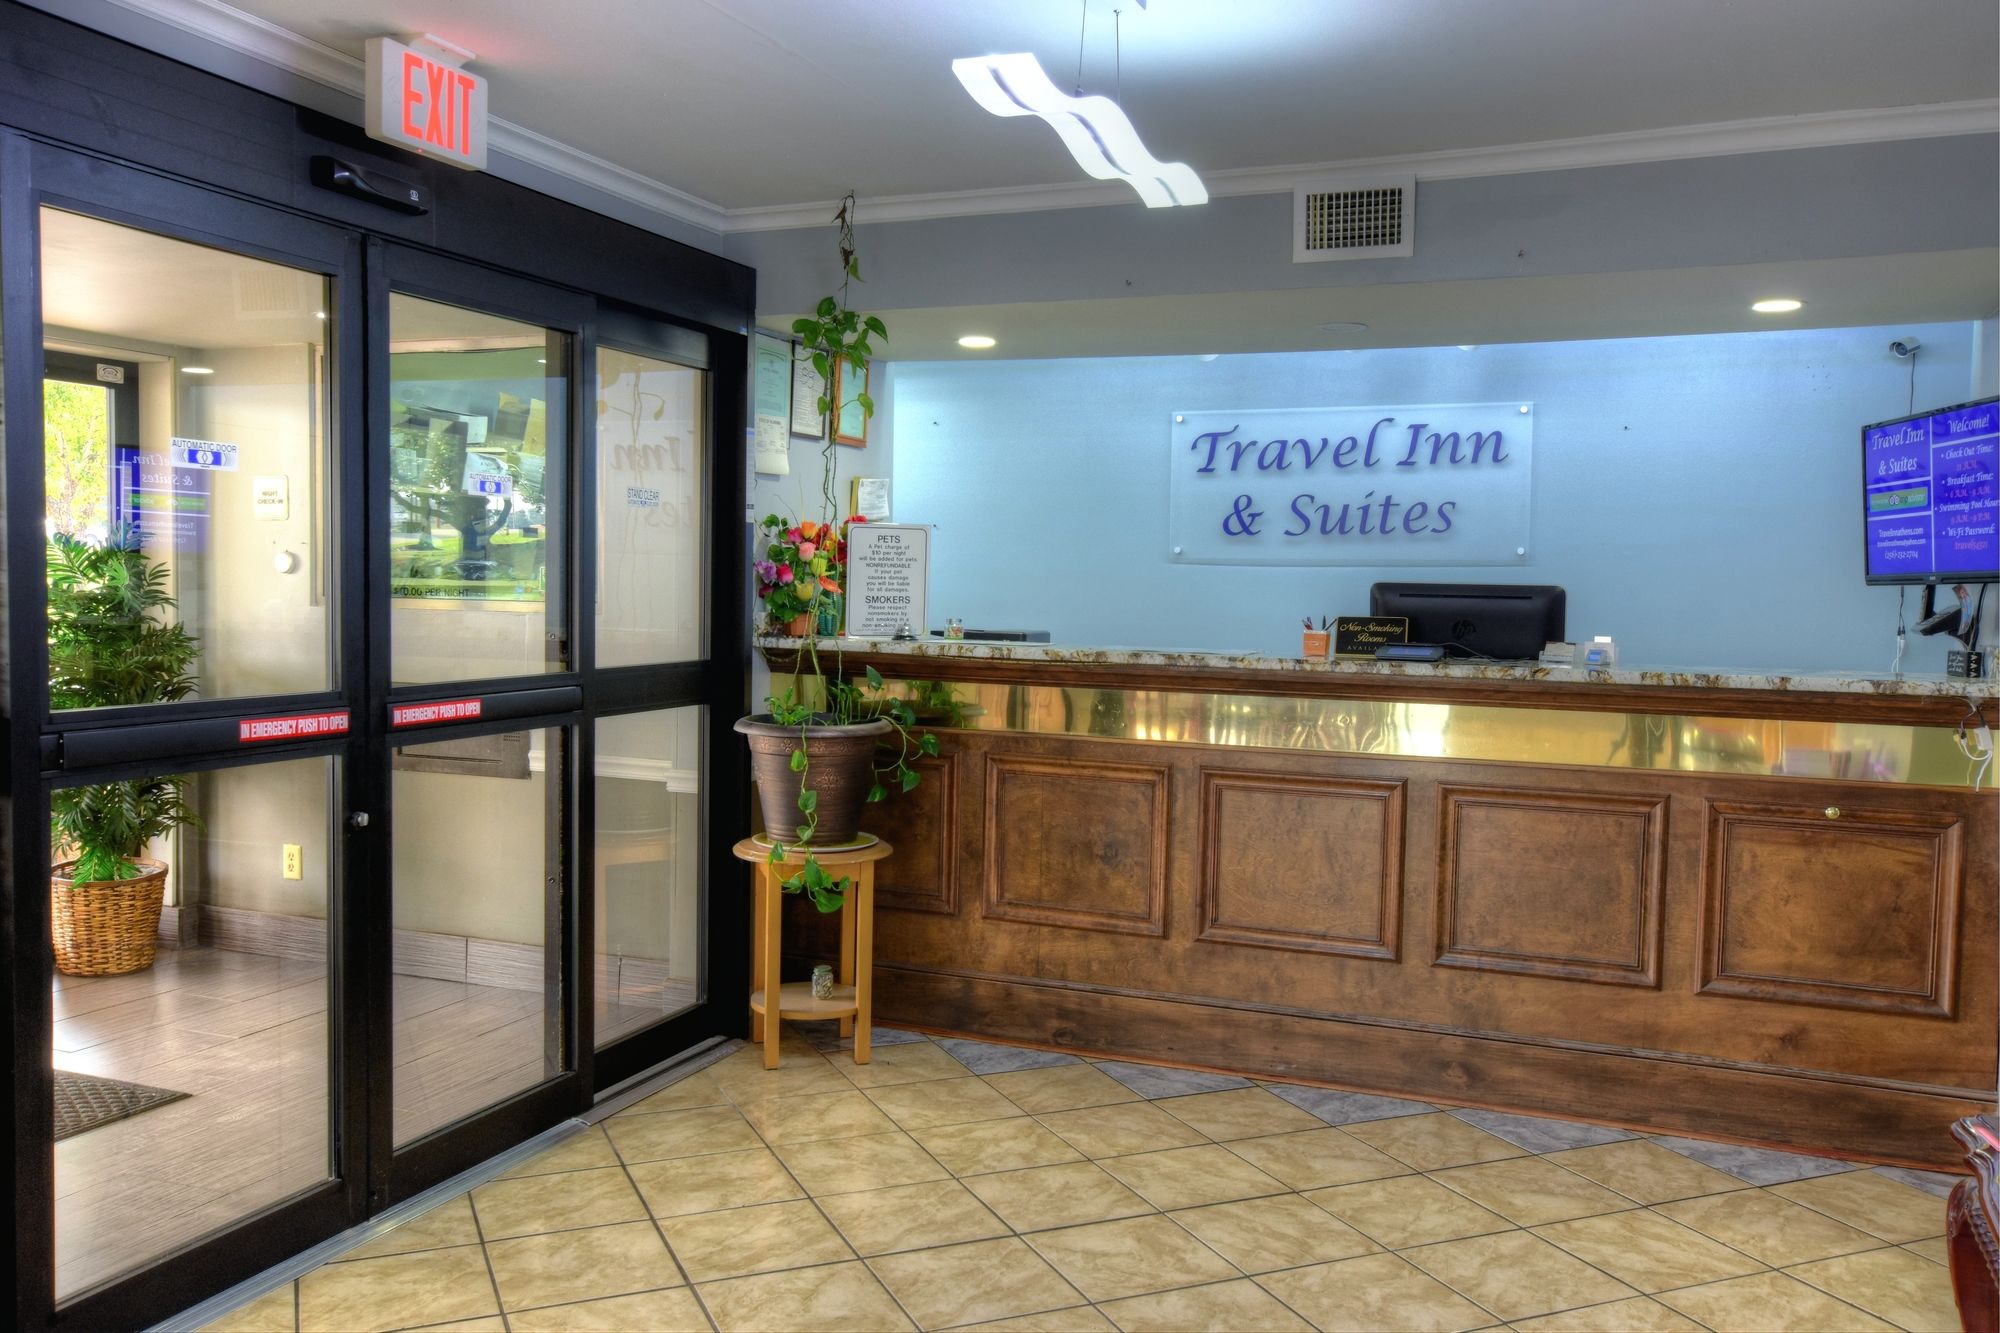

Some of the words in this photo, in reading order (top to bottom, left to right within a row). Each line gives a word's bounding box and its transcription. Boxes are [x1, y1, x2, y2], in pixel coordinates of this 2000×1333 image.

[402, 51, 476, 156] EXIT
[1948, 413, 1990, 434] Welcome!
[172, 439, 214, 452] AUTOMATIC
[214, 444, 237, 453] DOOR
[1191, 418, 1395, 473] Travel
[1396, 423, 1509, 466] Inn
[1872, 427, 1905, 450] Travel
[1905, 428, 1925, 443] Inn
[1878, 460, 1886, 475] &
[1888, 457, 1917, 474] Suites
[469, 473, 497, 482] AUTOMATIC
[497, 474, 512, 482] DOOR
[627, 488, 644, 500] STAND
[1222, 494, 1264, 537] &
[1284, 490, 1456, 537] Suites
[877, 535, 901, 543] PETS
[425, 588, 442, 596] PER
[442, 588, 470, 597] NIGHT
[865, 596, 911, 604] SMOKERS
[1340, 622, 1404, 636] Non-Smoking
[1353, 632, 1387, 643] Rooms
[393, 709, 402, 724] IN
[402, 705, 439, 722] EMERGENCY
[440, 704, 456, 718] PUSH
[456, 703, 465, 716] TO
[465, 702, 481, 716] OPEN
[240, 723, 250, 738] IN
[252, 718, 296, 738] EMERGENCY
[298, 717, 317, 734] PUSH
[319, 716, 329, 731] TO
[329, 715, 348, 730] OPEN
